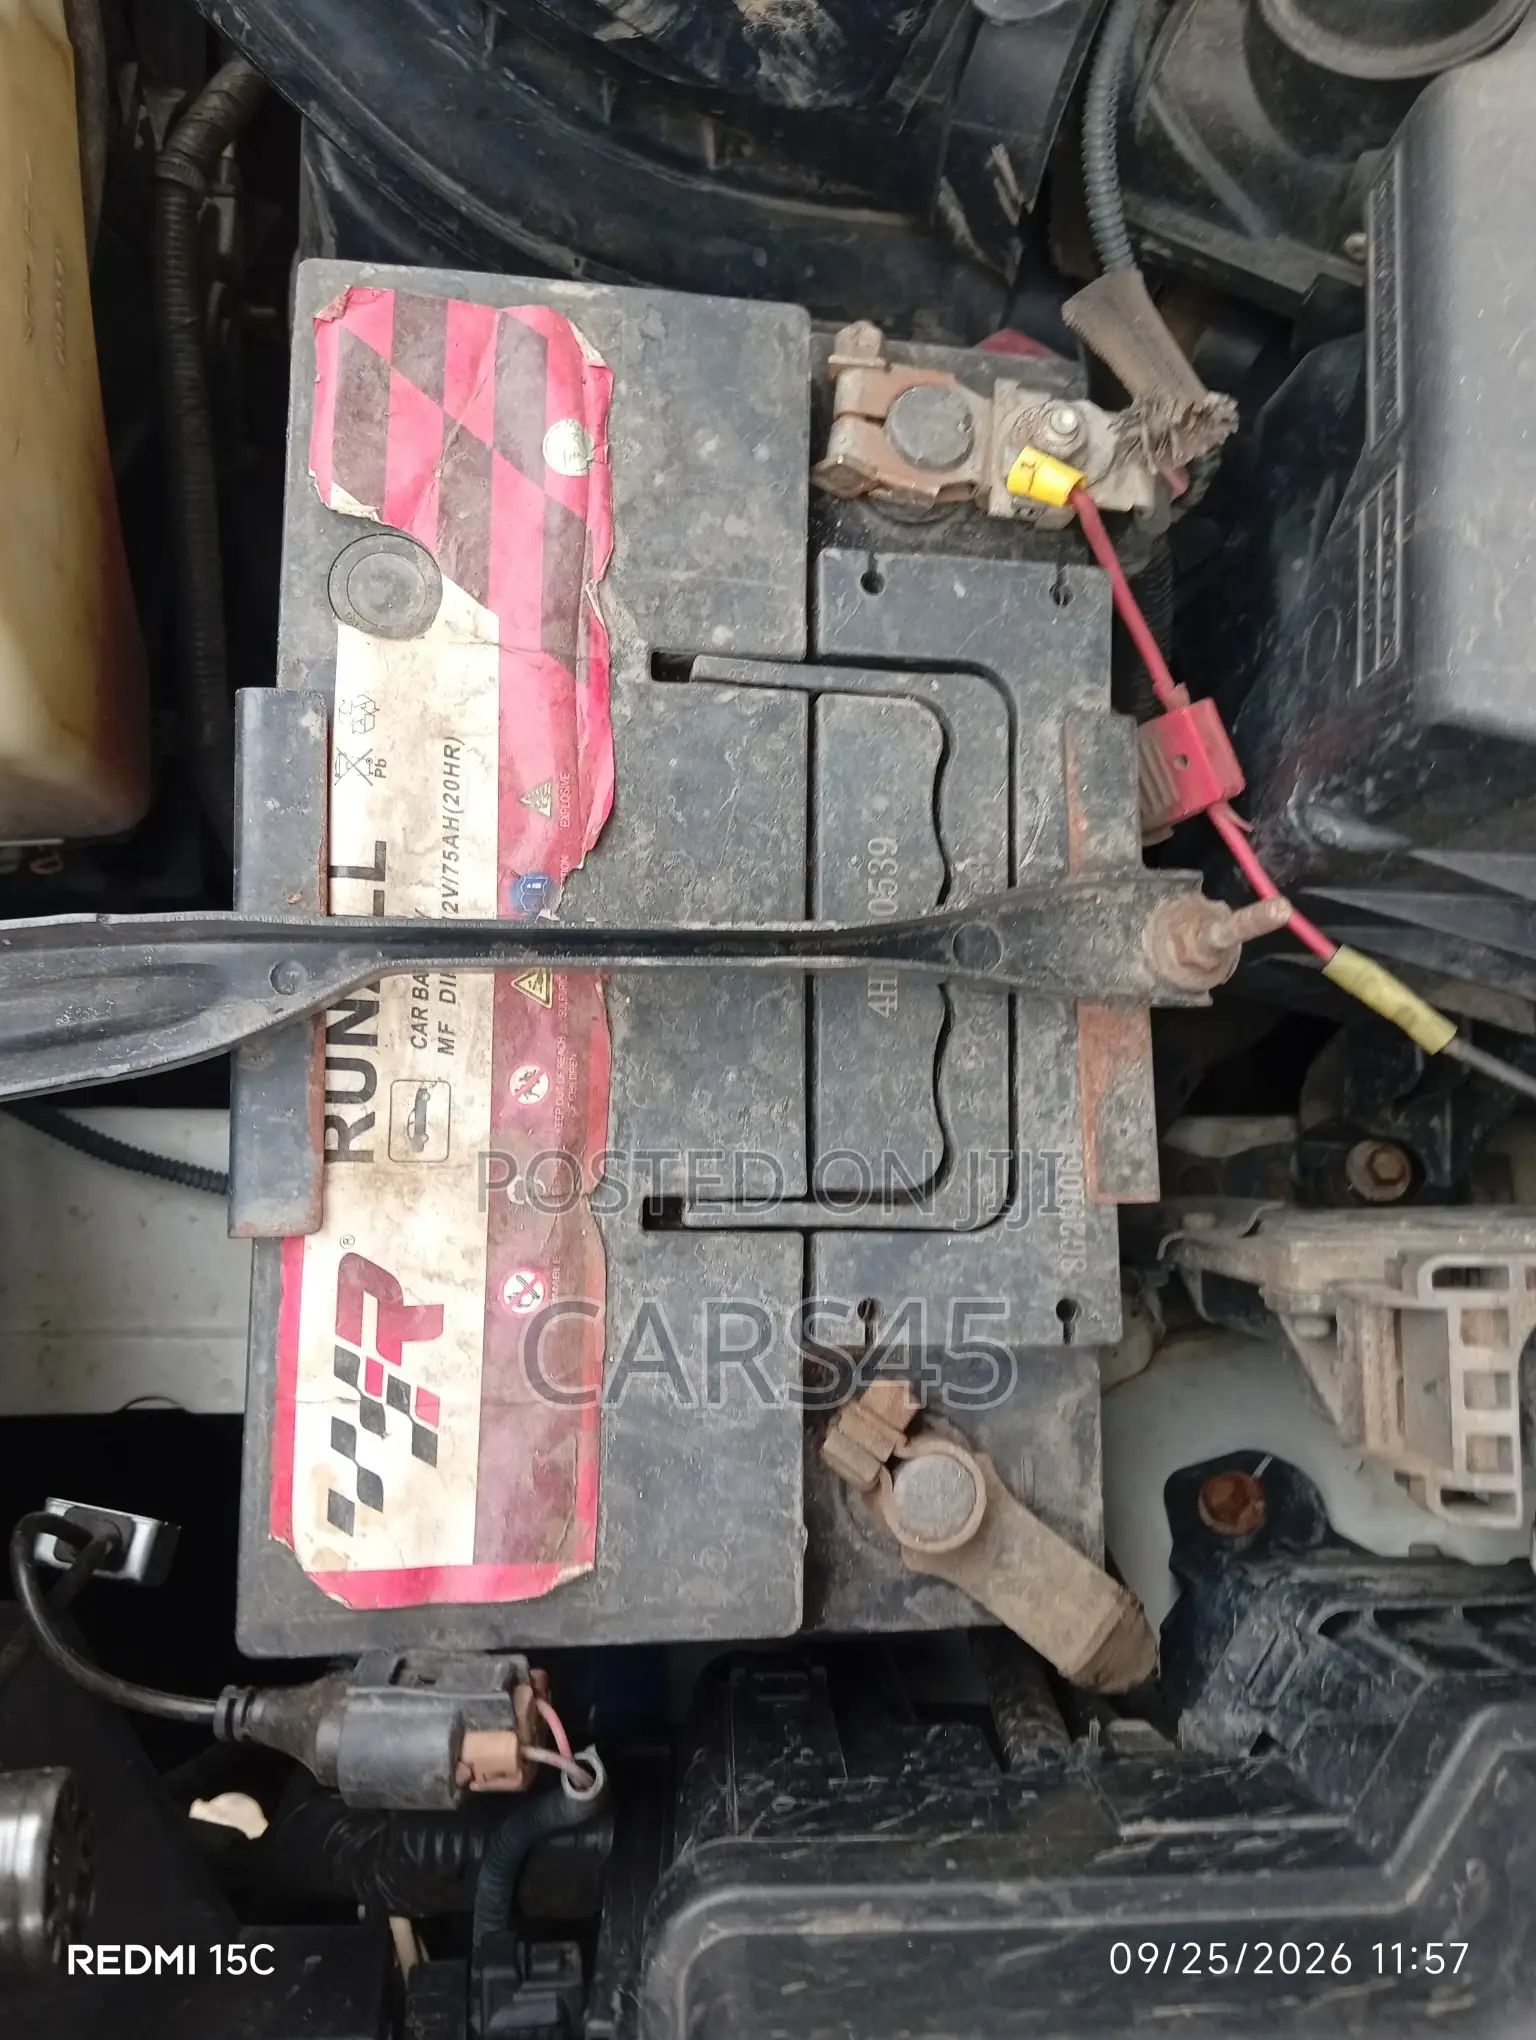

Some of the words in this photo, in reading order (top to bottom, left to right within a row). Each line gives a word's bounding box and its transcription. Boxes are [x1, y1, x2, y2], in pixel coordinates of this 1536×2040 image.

[374, 758, 388, 779] Pb
[558, 772, 571, 828] EXPLOSIVE
[440, 736, 465, 921] 2V/75AH(20HR)
[866, 835, 899, 1018] 4H0539
[326, 841, 387, 1164] RUNL
[410, 1007, 429, 1050] CAR
[437, 1023, 457, 1056] MF
[553, 1109, 564, 1134] EEP
